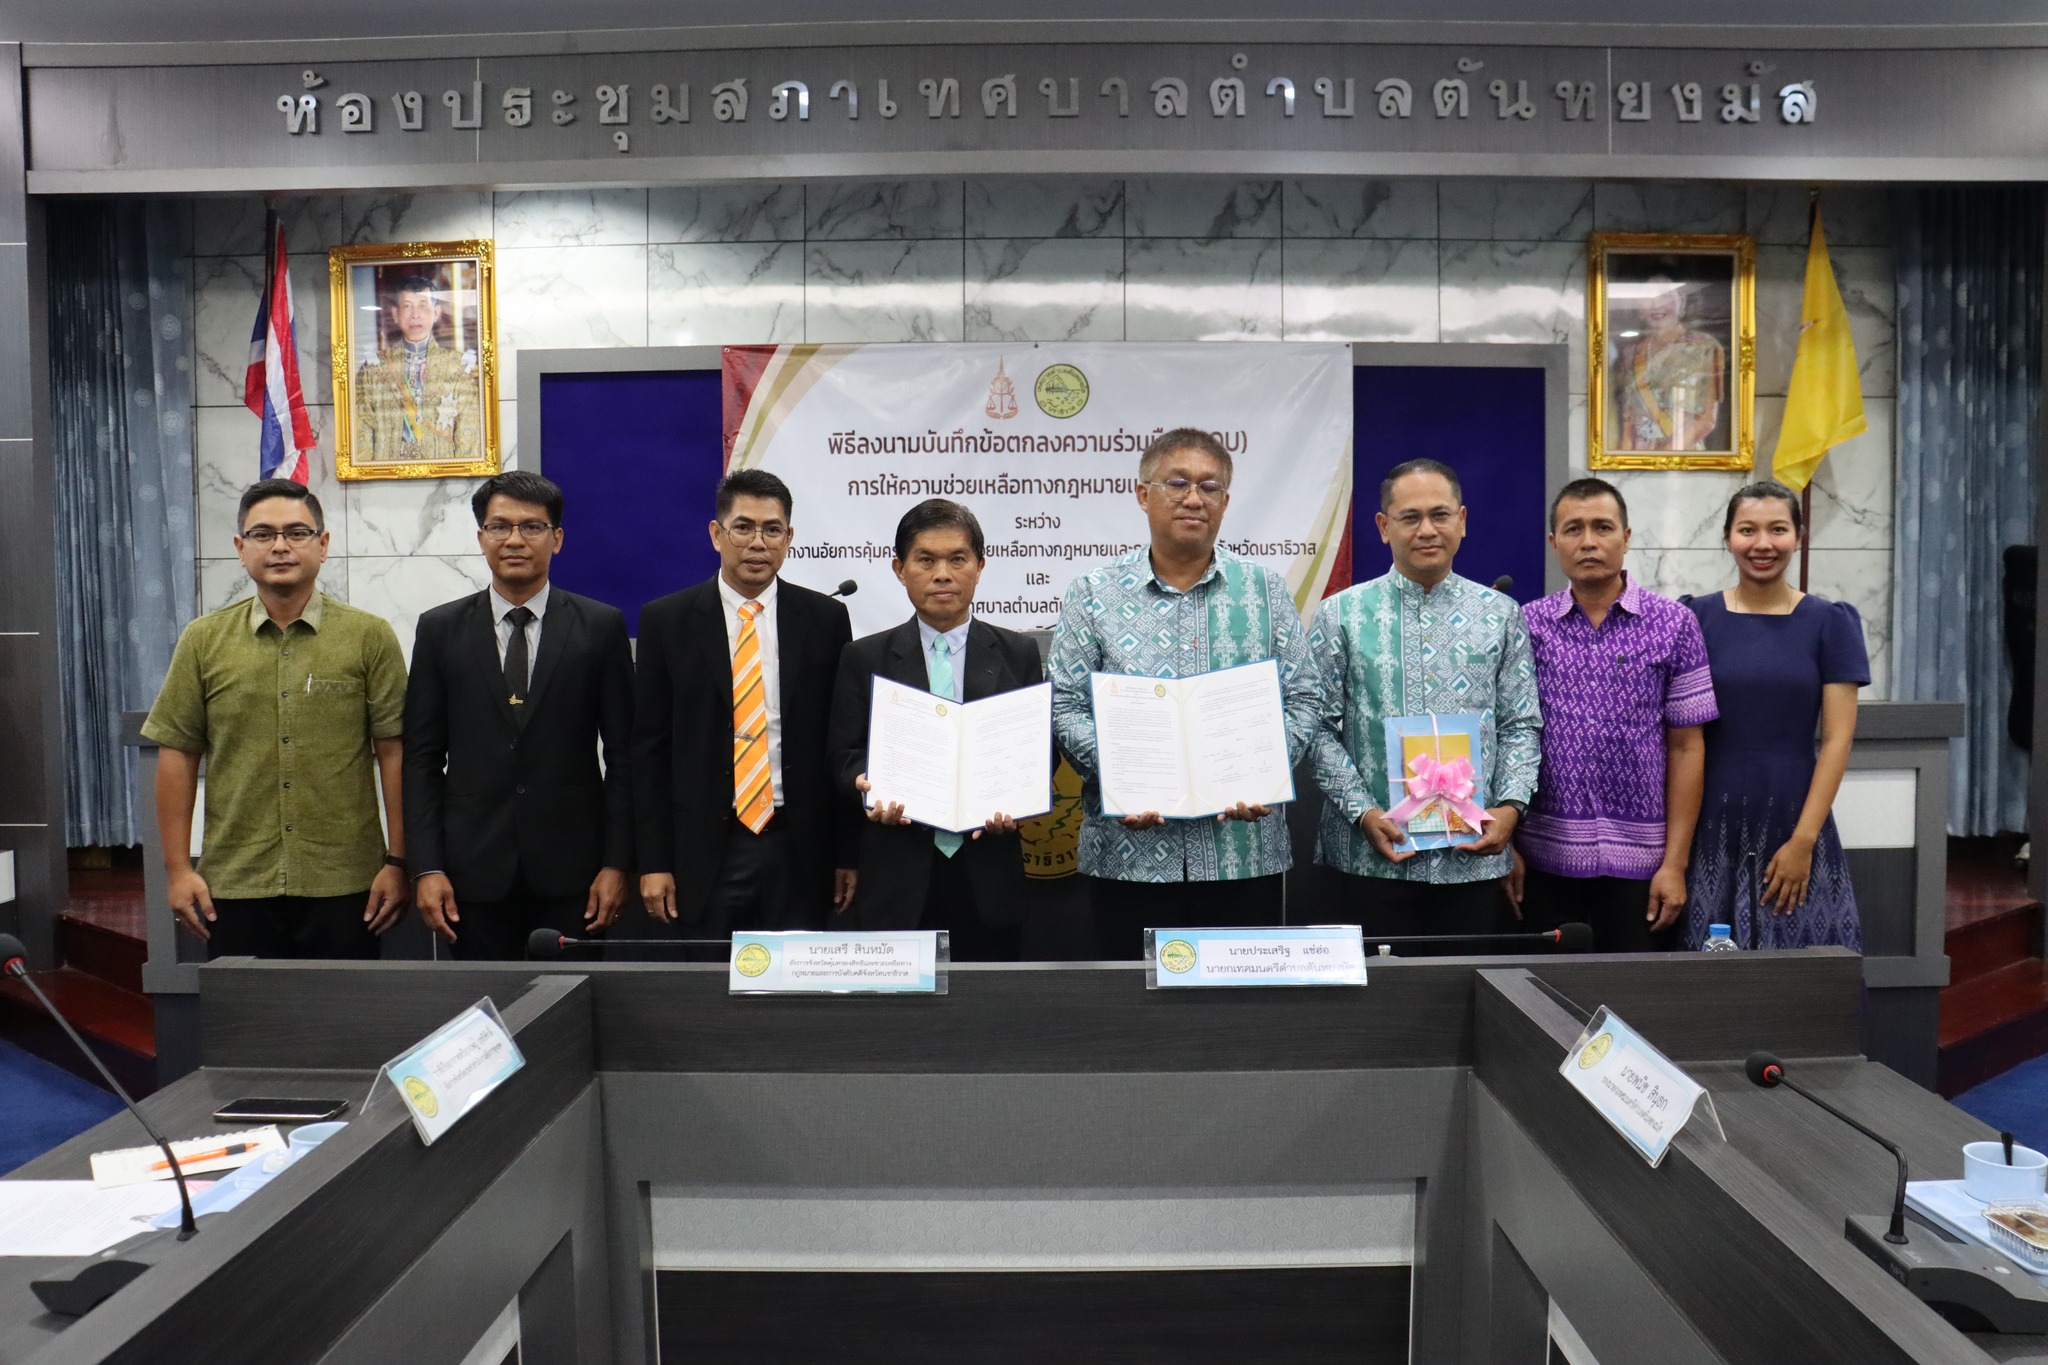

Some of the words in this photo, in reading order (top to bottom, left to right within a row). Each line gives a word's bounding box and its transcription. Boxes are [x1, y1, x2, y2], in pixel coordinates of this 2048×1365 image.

[276, 52, 1817, 151] ห้องประชุมสภาเทศบาลตำบลตันหยงมัส
[848, 472, 1137, 499] การให้ความช่วยเหลือทางกฎหมายแ
[1015, 512, 1061, 529] ระหว่าง
[1026, 572, 1050, 585] และ
[1024, 848, 1077, 866] ราธิวา
[809, 944, 848, 955] นายเสรี
[1229, 944, 1291, 956] นายประเสริฐ
